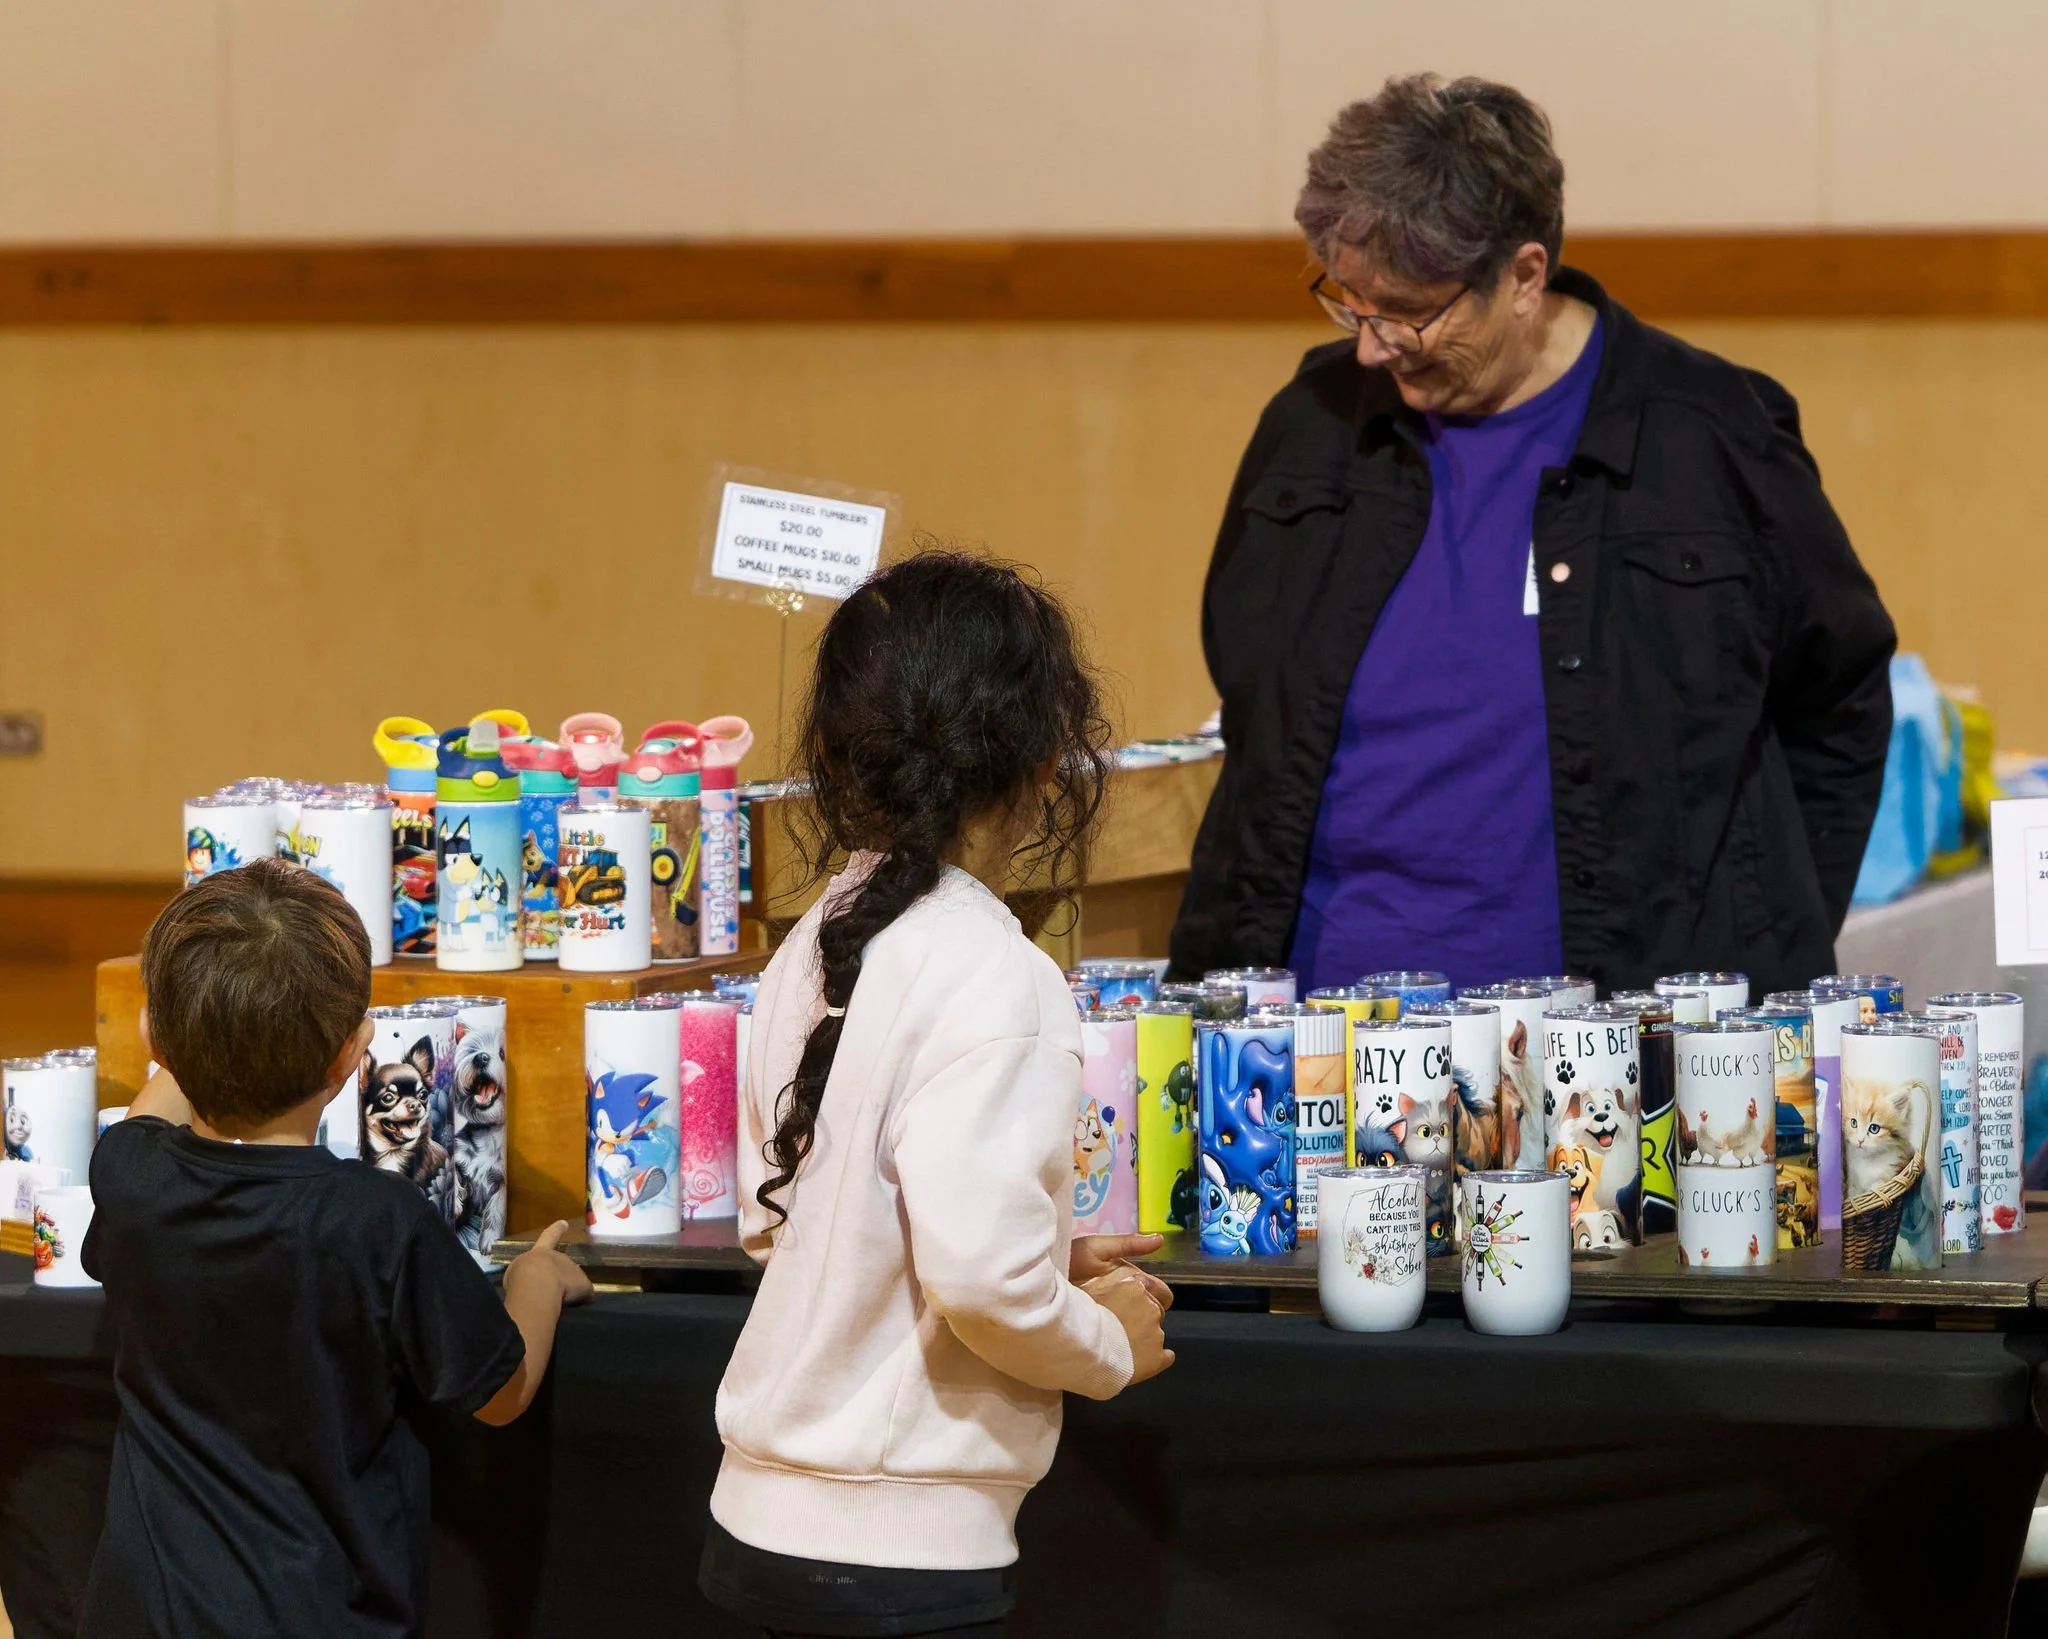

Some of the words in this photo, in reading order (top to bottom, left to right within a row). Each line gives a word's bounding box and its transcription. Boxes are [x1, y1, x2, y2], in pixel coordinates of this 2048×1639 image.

[740, 494, 786, 511] STAINLESS
[789, 502, 816, 516] STEEL
[820, 508, 868, 525] TUMBLERS
[780, 520, 823, 538] $20.00
[734, 535, 779, 552] COFFEE
[783, 543, 817, 560] MUGS
[821, 550, 861, 567] $10.00
[737, 558, 774, 574] SMALL
[778, 565, 812, 580] MUGS
[816, 571, 851, 587] $5.00
[709, 810, 727, 938] DOLLHOUSE
[580, 911, 626, 930] Hurt
[1947, 1023, 1961, 1035] AND
[1543, 1032, 1566, 1060] LIFE
[1577, 1032, 1595, 1058] IS
[1940, 1049, 1958, 1060] IVEN
[1690, 1053, 1760, 1077] CLUCK'S
[1978, 1064, 2015, 1079] BRAVER
[1368, 1181, 1420, 1212] Alcohol
[1692, 1188, 1761, 1213] CLUCK'S
[1369, 1211, 1407, 1221] BECAUSE
[1408, 1210, 1420, 1220] YOU
[1366, 1225, 1391, 1234] CAN'T
[1393, 1224, 1408, 1233] RUN
[1409, 1222, 1421, 1232] THIS
[1360, 1233, 1423, 1255] shitshow
[1394, 1249, 1422, 1276] Sober
